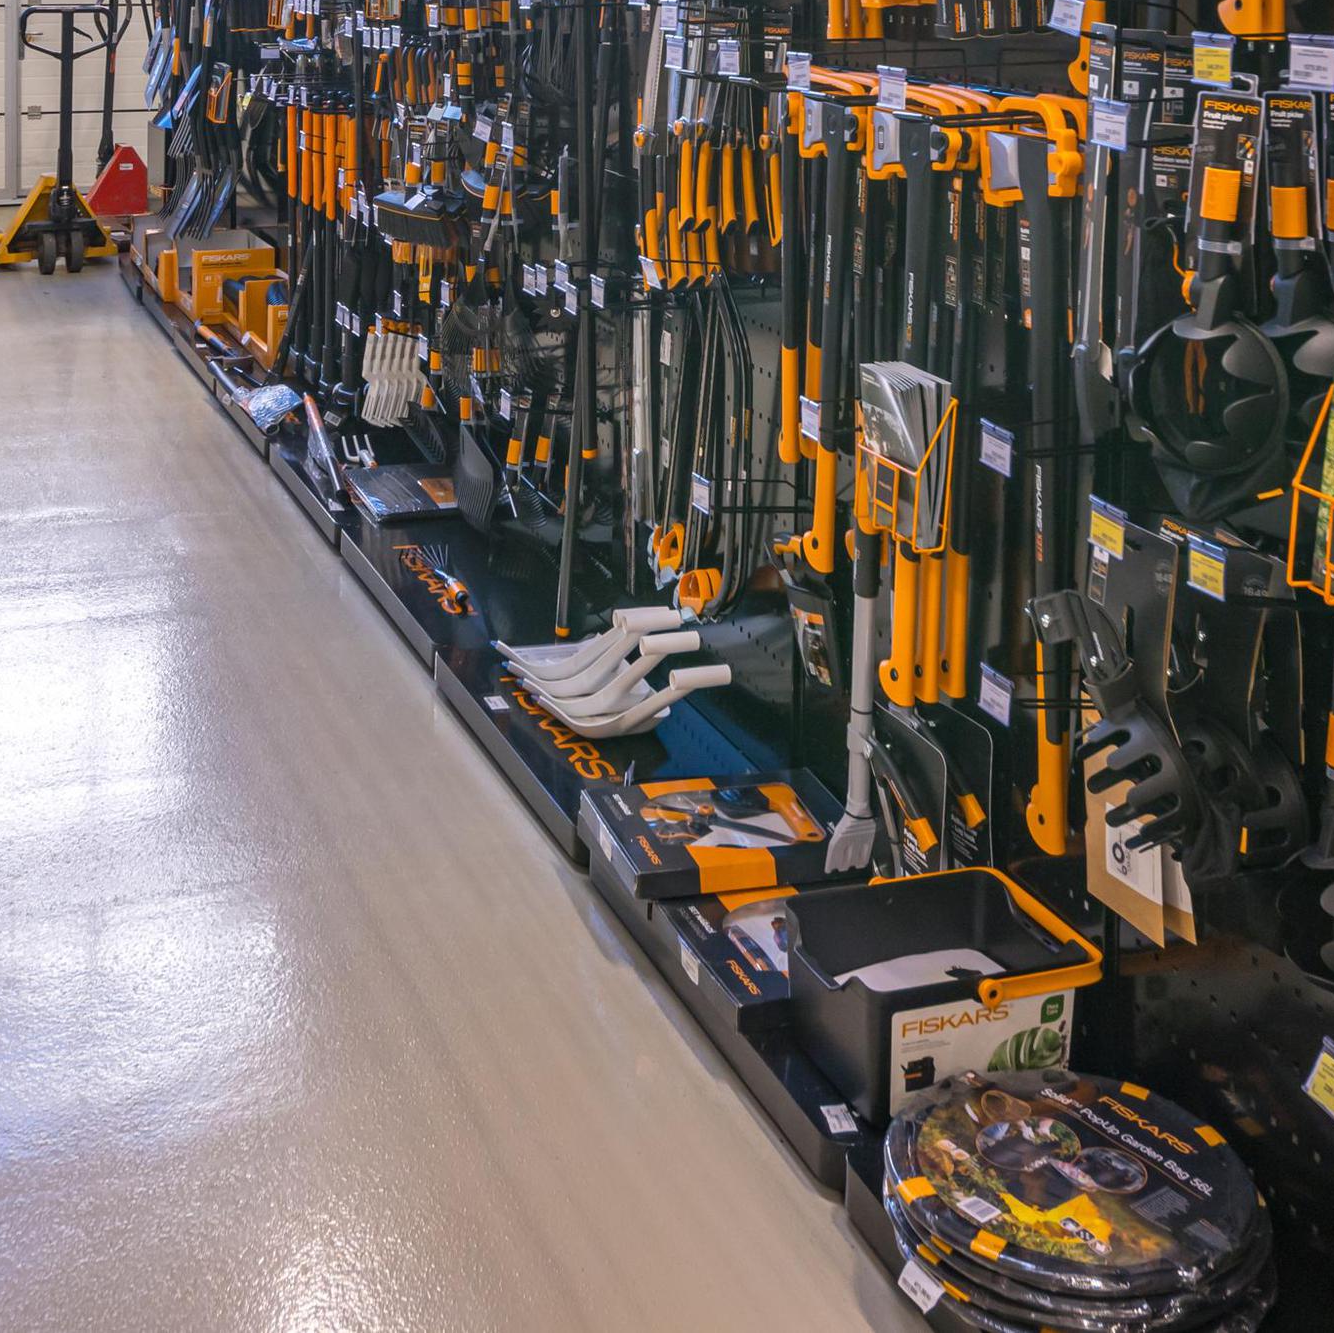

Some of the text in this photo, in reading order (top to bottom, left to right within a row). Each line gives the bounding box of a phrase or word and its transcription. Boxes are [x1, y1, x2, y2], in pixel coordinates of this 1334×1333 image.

[1204, 99, 1261, 116] FISKARS
[906, 272, 915, 324] FISKARS
[1036, 465, 1044, 531] FISKARS
[635, 835, 662, 866] FISKARS
[726, 959, 762, 996] FISKARS
[901, 1004, 1009, 1039] FISKARS
[1098, 1096, 1195, 1155] FISKARS
[1079, 1108, 1121, 1136] PopUp
[1120, 1133, 1164, 1163] Garden
[1163, 1160, 1191, 1181] Bag
[1189, 1177, 1214, 1198] 56L
